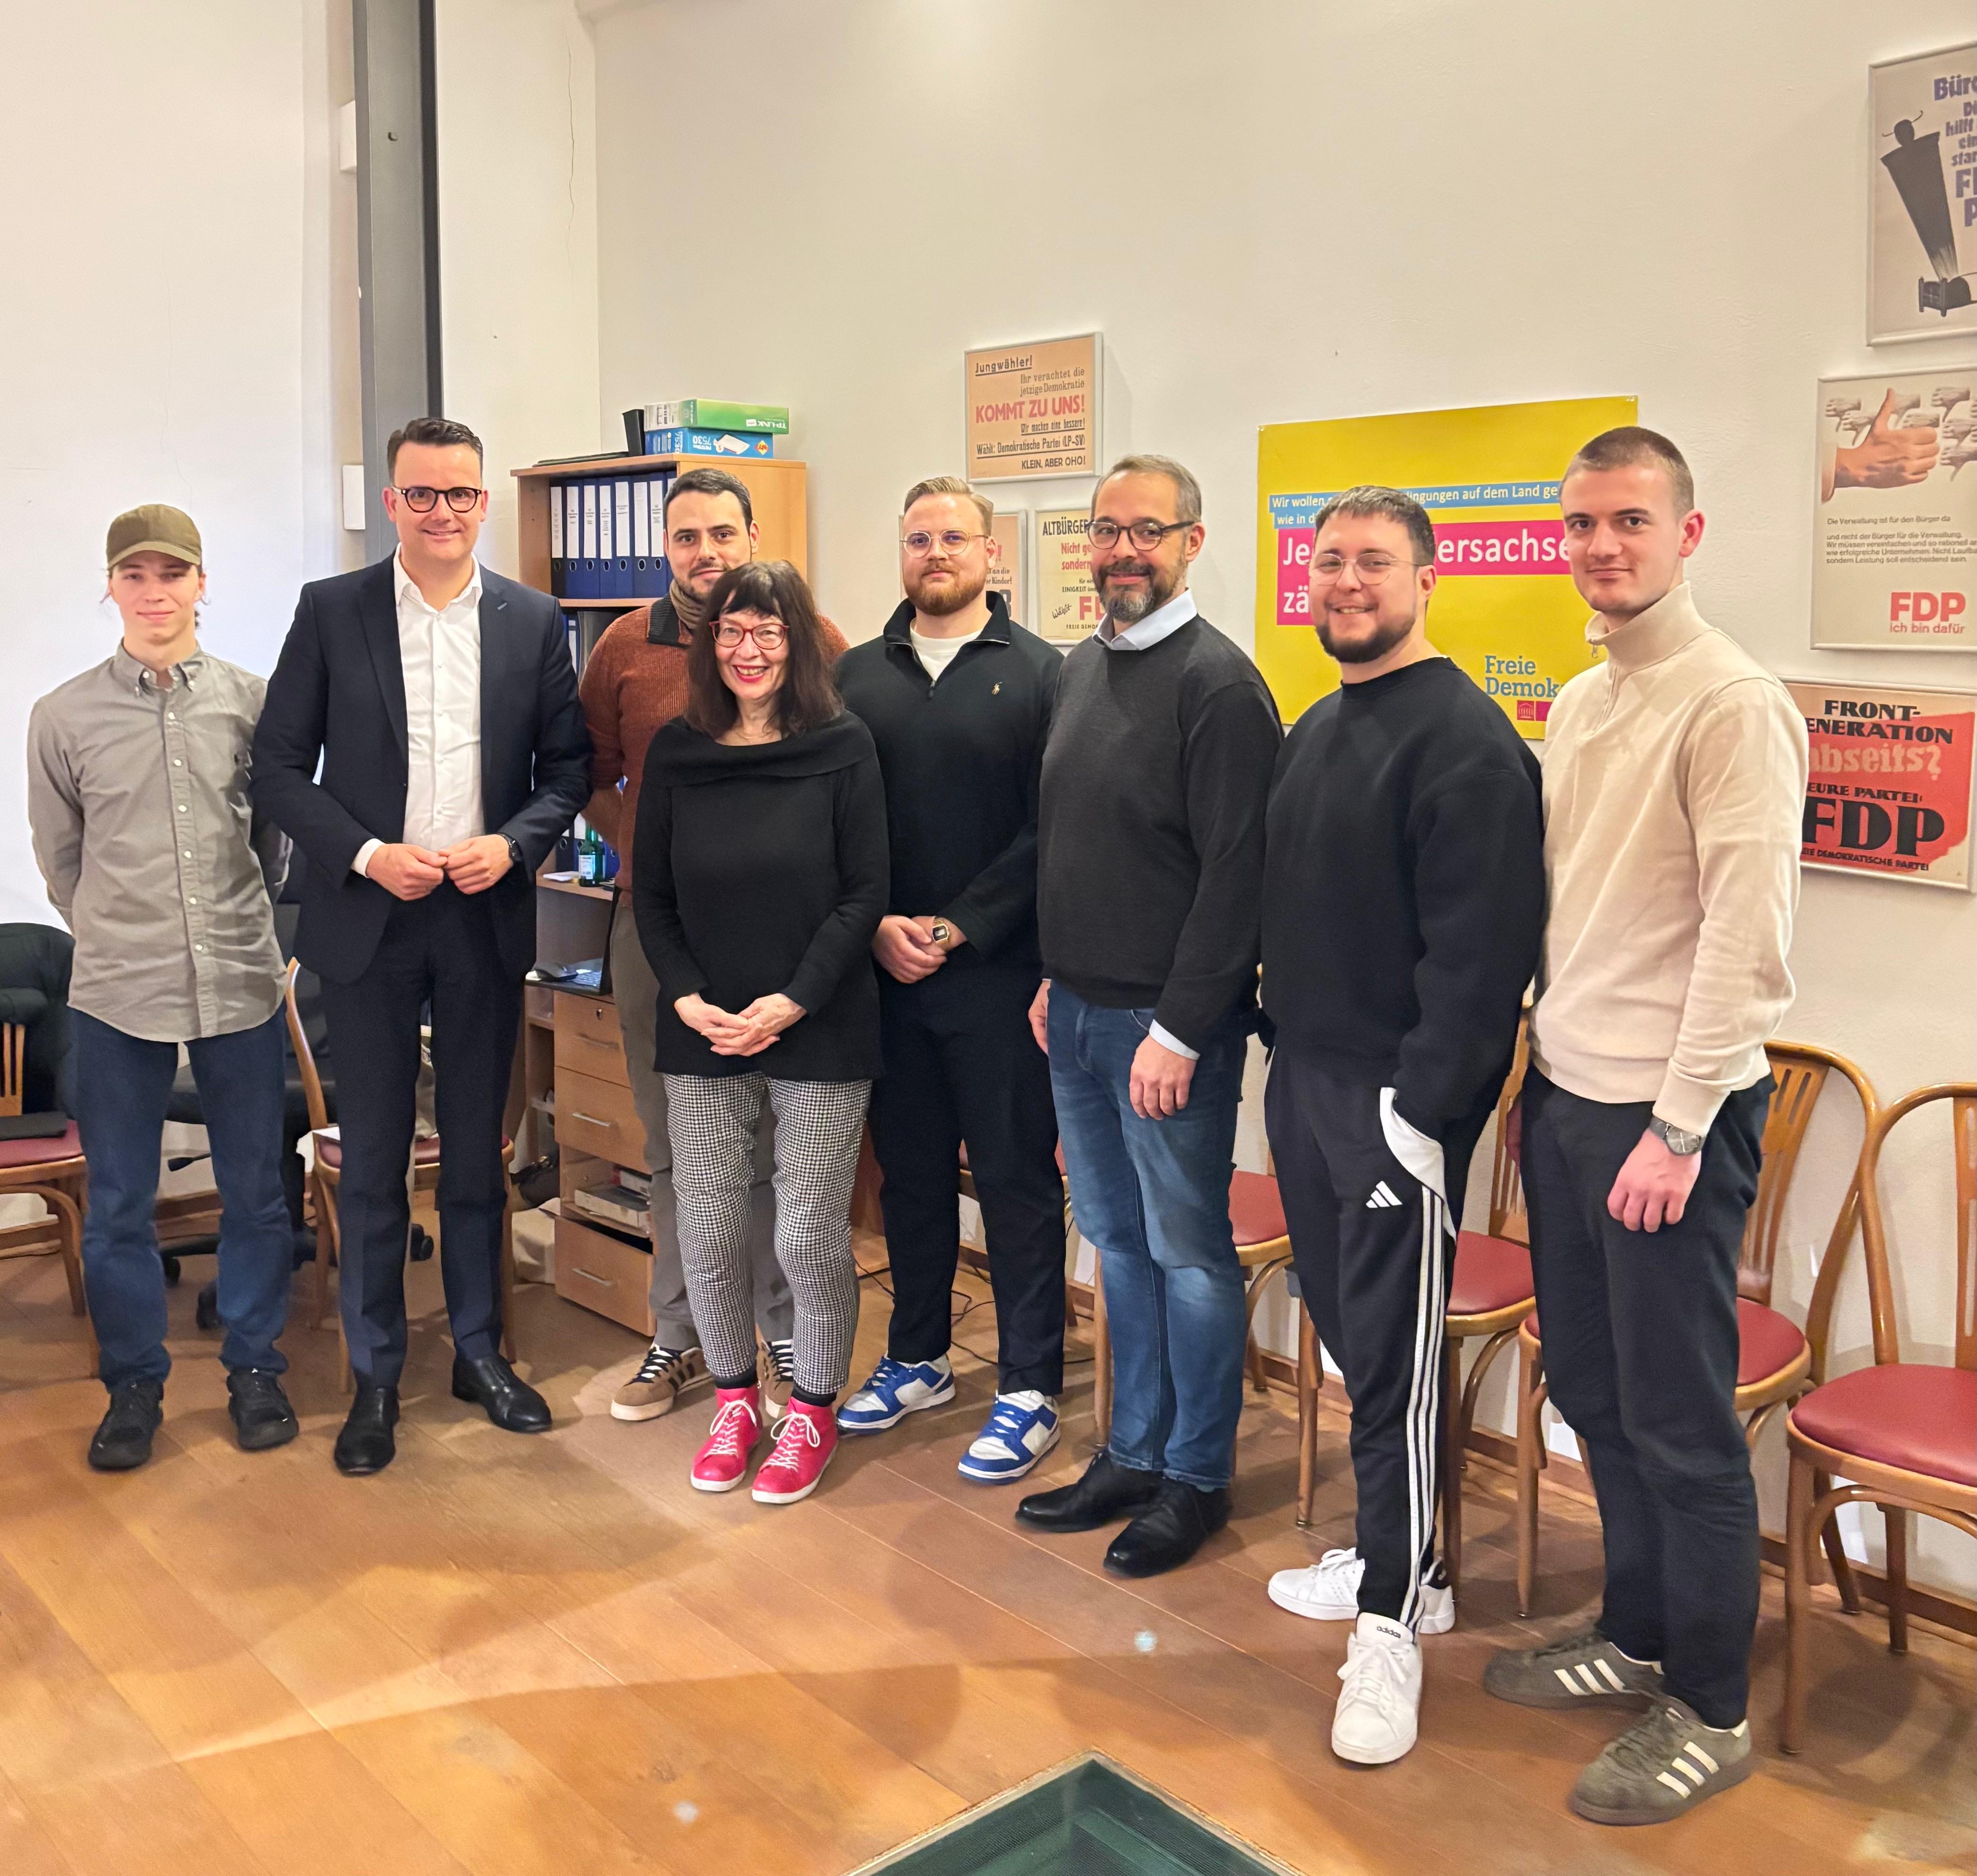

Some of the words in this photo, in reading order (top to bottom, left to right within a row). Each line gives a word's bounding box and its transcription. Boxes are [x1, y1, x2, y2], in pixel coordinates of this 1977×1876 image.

[975, 355, 1032, 373] Jungwähler!
[1021, 374, 1031, 383] Ihr
[1034, 369, 1071, 382] verachtet
[1073, 367, 1084, 376] die
[1020, 385, 1043, 397] jetzige
[1044, 380, 1084, 392] Demokratie
[975, 401, 1025, 423] KOMMT
[1028, 399, 1048, 418] ZU
[1052, 394, 1085, 415] UNS!
[1031, 421, 1048, 432] machen
[1051, 421, 1061, 429] eine
[1064, 418, 1085, 428] bessere!
[693, 435, 711, 445] 7530
[977, 443, 995, 455] Wählt:
[998, 440, 1039, 453] Demokratische
[1043, 436, 1060, 449] Partei
[1063, 434, 1085, 446] (LP-SV)
[1022, 459, 1043, 469] KLEIN,
[1045, 458, 1063, 467] ABER
[1065, 456, 1085, 466] OHO!
[1463, 487, 1481, 500] auf
[1484, 486, 1508, 498] dem
[1513, 486, 1539, 497] Land
[1272, 497, 1289, 508] Wir
[1292, 495, 1324, 507] wollen
[1277, 514, 1294, 524] wie
[1297, 513, 1305, 524] in
[1061, 543, 1080, 554] Nicht
[992, 576, 1012, 584] Kinder!
[1890, 592, 1966, 622] FDP
[1890, 623, 1907, 633] ich
[1912, 623, 1929, 633] bin
[1933, 623, 1964, 634] dafür
[1485, 655, 1536, 675] Freie
[1485, 677, 1564, 697] Demok
[1824, 700, 1921, 721] FRONT-
[1805, 717, 1953, 744] ENERATION
[1807, 782, 1849, 796] EURE
[1802, 796, 1945, 857] FDP
[1817, 850, 1893, 866] DEMOKRATISCHE
[1896, 860, 1929, 871] PARTEI
